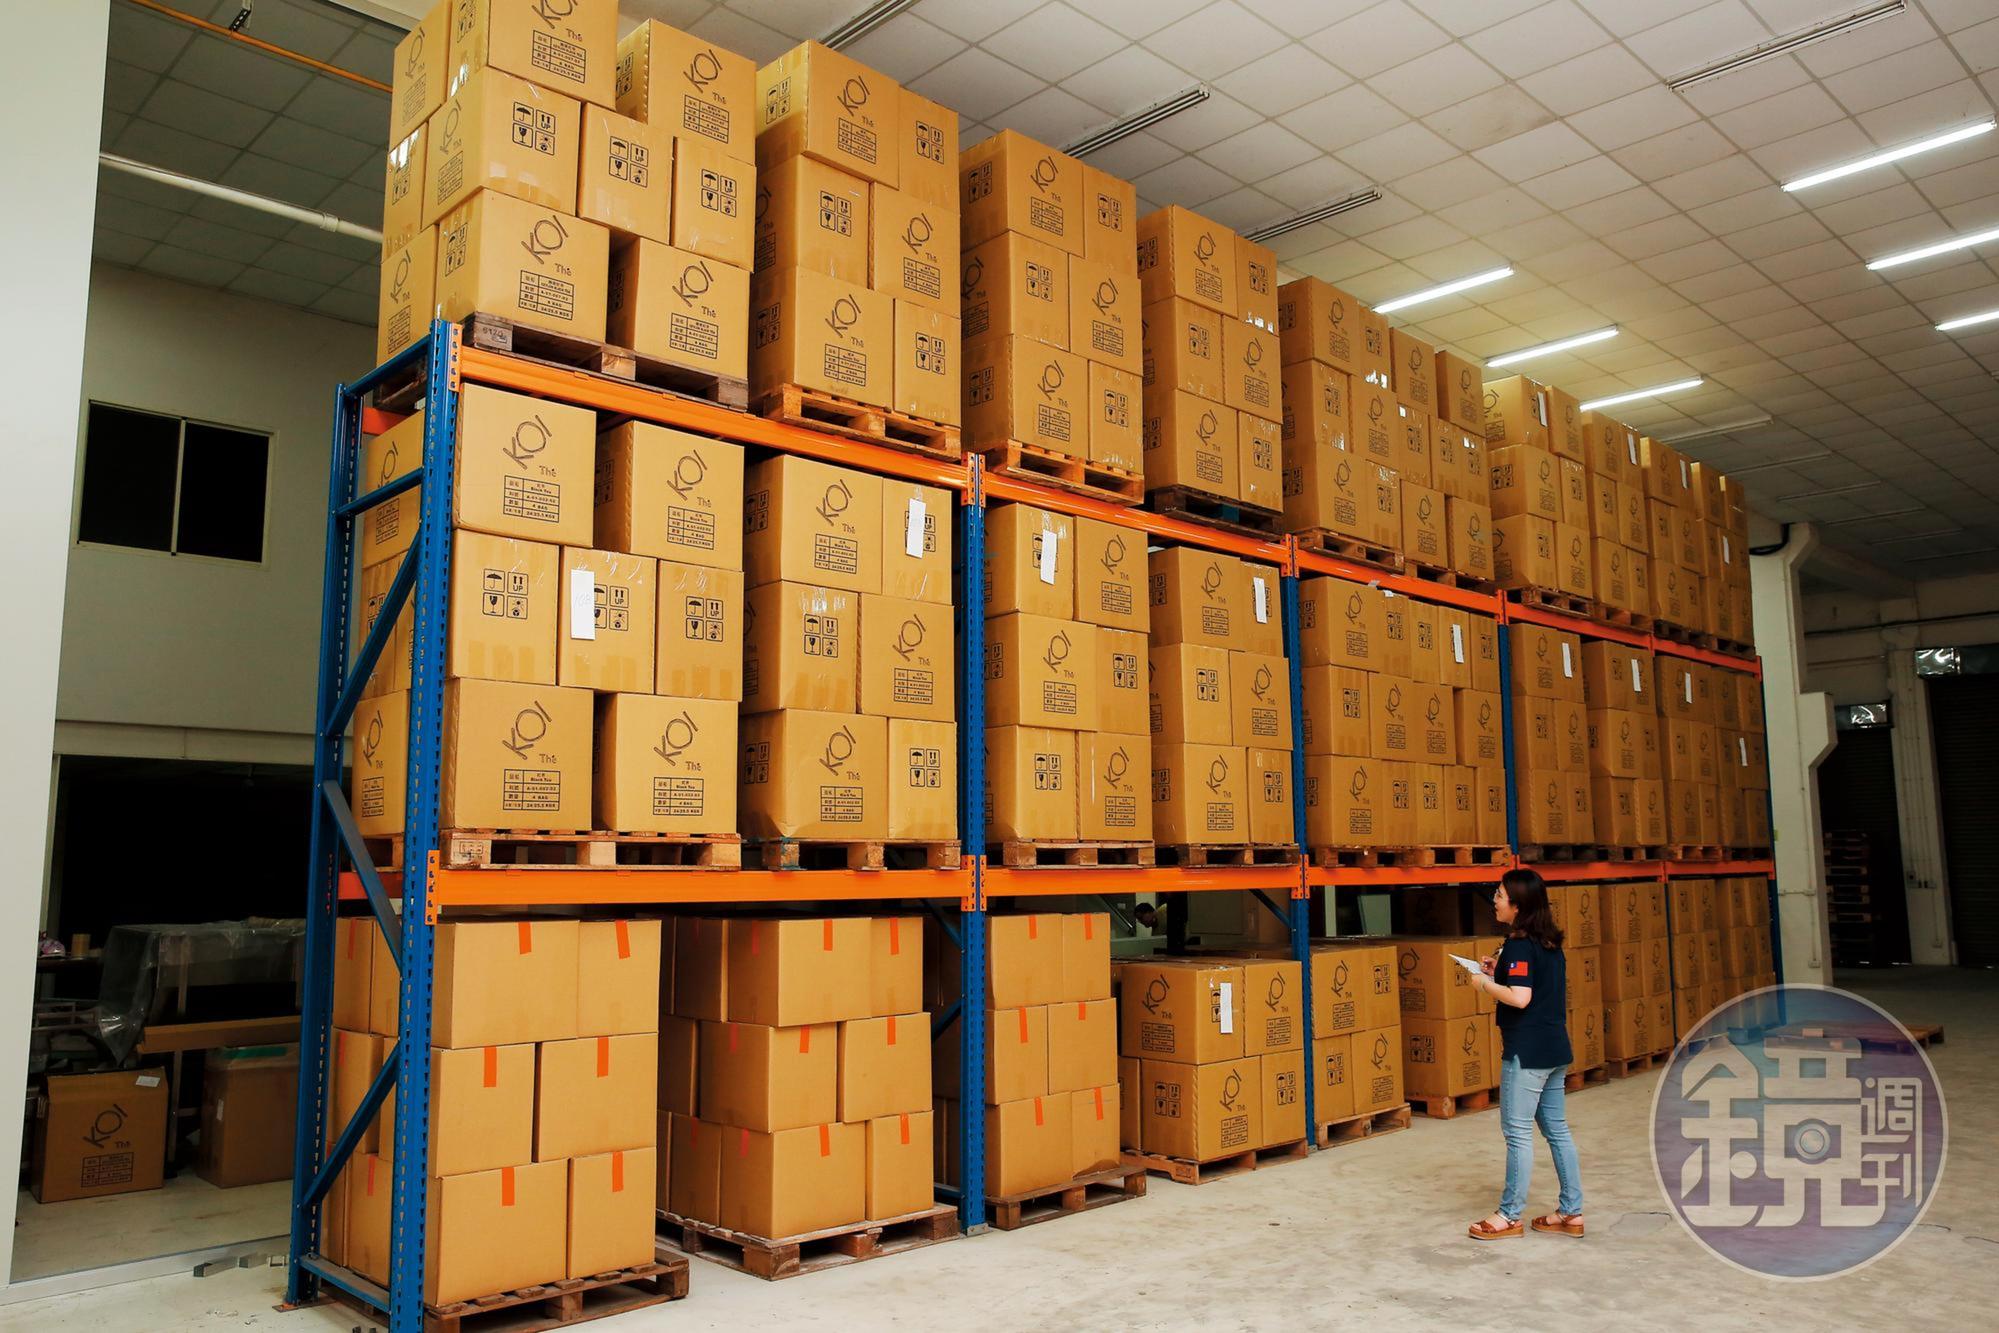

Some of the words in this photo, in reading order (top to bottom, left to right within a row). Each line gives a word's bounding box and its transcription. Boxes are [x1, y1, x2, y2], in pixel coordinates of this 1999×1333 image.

[683, 49, 722, 93] KOI
[837, 76, 870, 117] KOI
[1030, 156, 1058, 193] KOI
[521, 215, 568, 264] KOI
[902, 213, 933, 254] KOI
[1194, 232, 1216, 267] KOI
[390, 250, 411, 304] KOI
[672, 261, 714, 308] KOI
[1092, 278, 1118, 316] KOI
[825, 294, 861, 338] KOI
[1244, 338, 1263, 372] KOI
[1037, 360, 1064, 400] KOI
[503, 415, 552, 470] KOI
[1196, 409, 1218, 446] KOI
[667, 450, 707, 501] KOI
[1334, 460, 1351, 492] KOI
[816, 479, 853, 526] KOI
[1101, 534, 1126, 575] KOI
[1201, 562, 1223, 600] KOI
[1345, 591, 1363, 624] KOI
[892, 614, 926, 662] KOI
[1043, 630, 1072, 673] KOI
[1251, 664, 1272, 701] KOI
[363, 710, 384, 766] KOI
[502, 700, 552, 760] KOI
[654, 711, 698, 766] KOI
[819, 725, 856, 776] KOI
[1104, 746, 1129, 789] KOI
[1206, 755, 1228, 794] KOI
[1350, 766, 1368, 802] KOI
[1142, 974, 1169, 1015] KOI
[1265, 971, 1285, 1012] KOI
[1331, 960, 1348, 997] KOI
[1371, 1033, 1389, 1070] KOI
[1462, 1021, 1475, 1057] KOI
[1219, 1068, 1242, 1112] KOI
[82, 1104, 128, 1148] KOI
